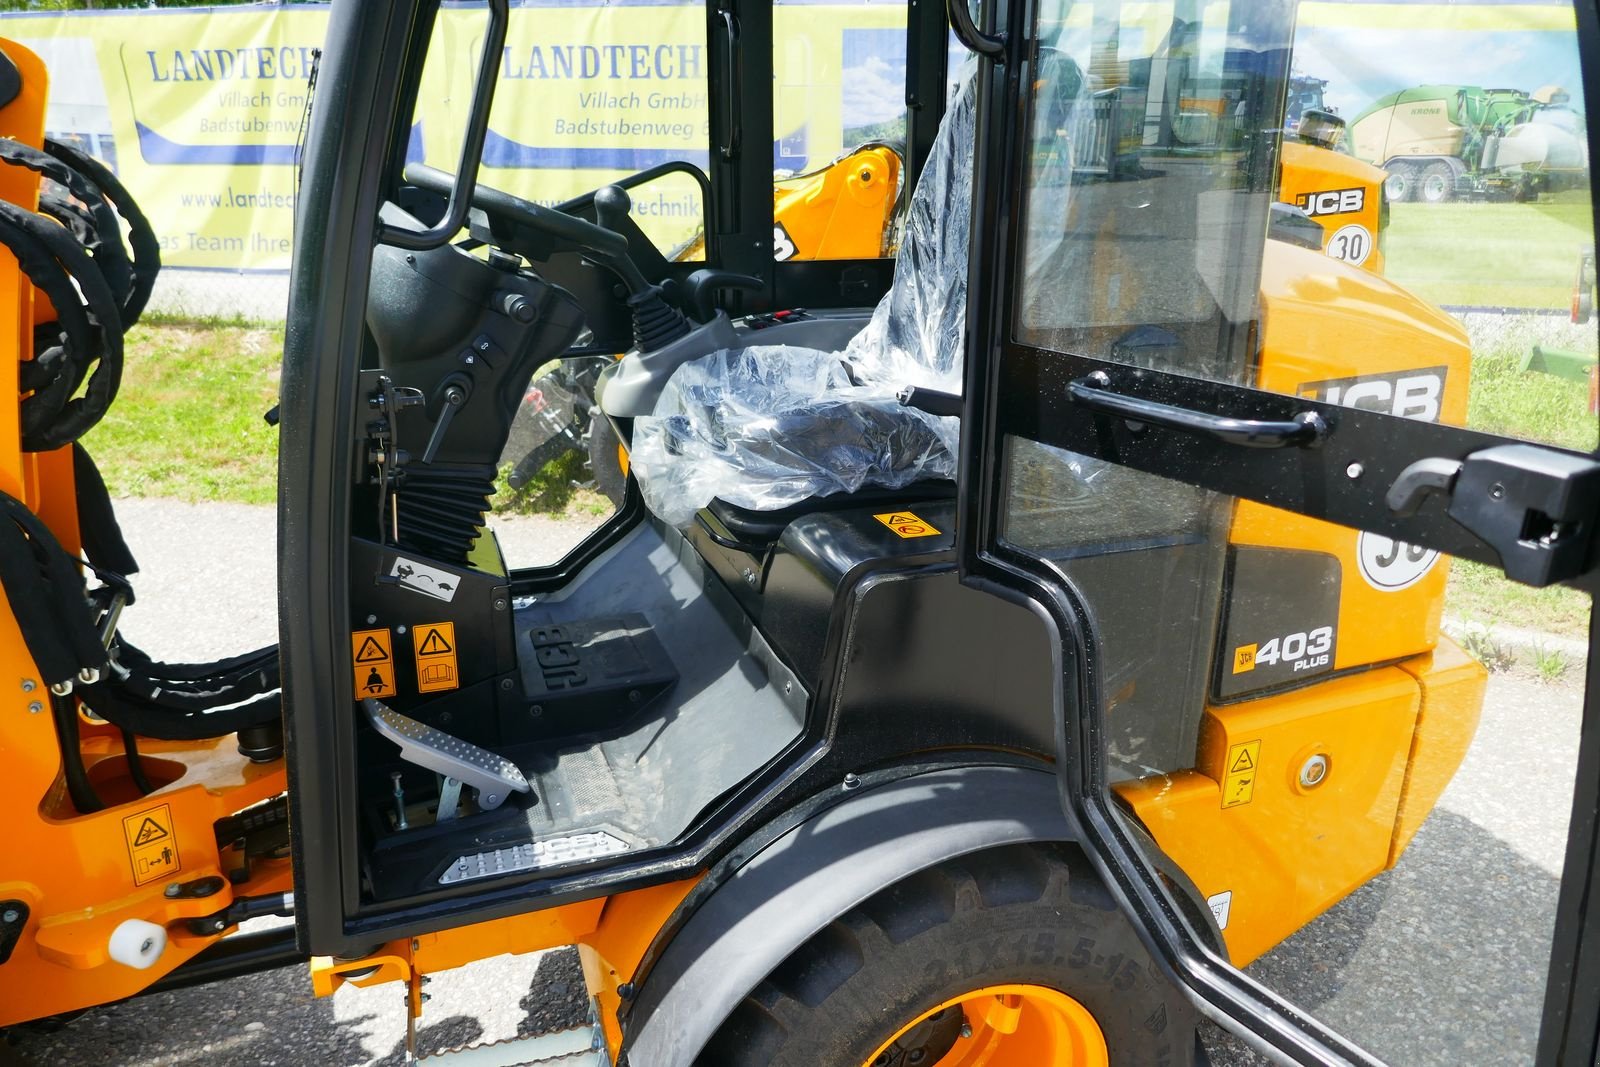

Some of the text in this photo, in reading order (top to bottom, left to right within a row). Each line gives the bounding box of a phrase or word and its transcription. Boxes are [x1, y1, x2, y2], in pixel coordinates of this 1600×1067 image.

[146, 47, 312, 82] LANDTECH
[502, 44, 707, 80] LANDTECH
[218, 91, 307, 108] Villach Gm
[578, 91, 706, 109] Villach GmbH
[1411, 107, 1441, 116] KRONE
[554, 117, 695, 140] Badstubenweg
[181, 186, 298, 209] www.landtec
[1299, 189, 1363, 216] JCB
[159, 232, 292, 253] as Team Ihre
[1336, 233, 1363, 261] 30
[1255, 625, 1333, 666] 403
[530, 625, 587, 690] JCB
[1293, 654, 1329, 672] PLUS
